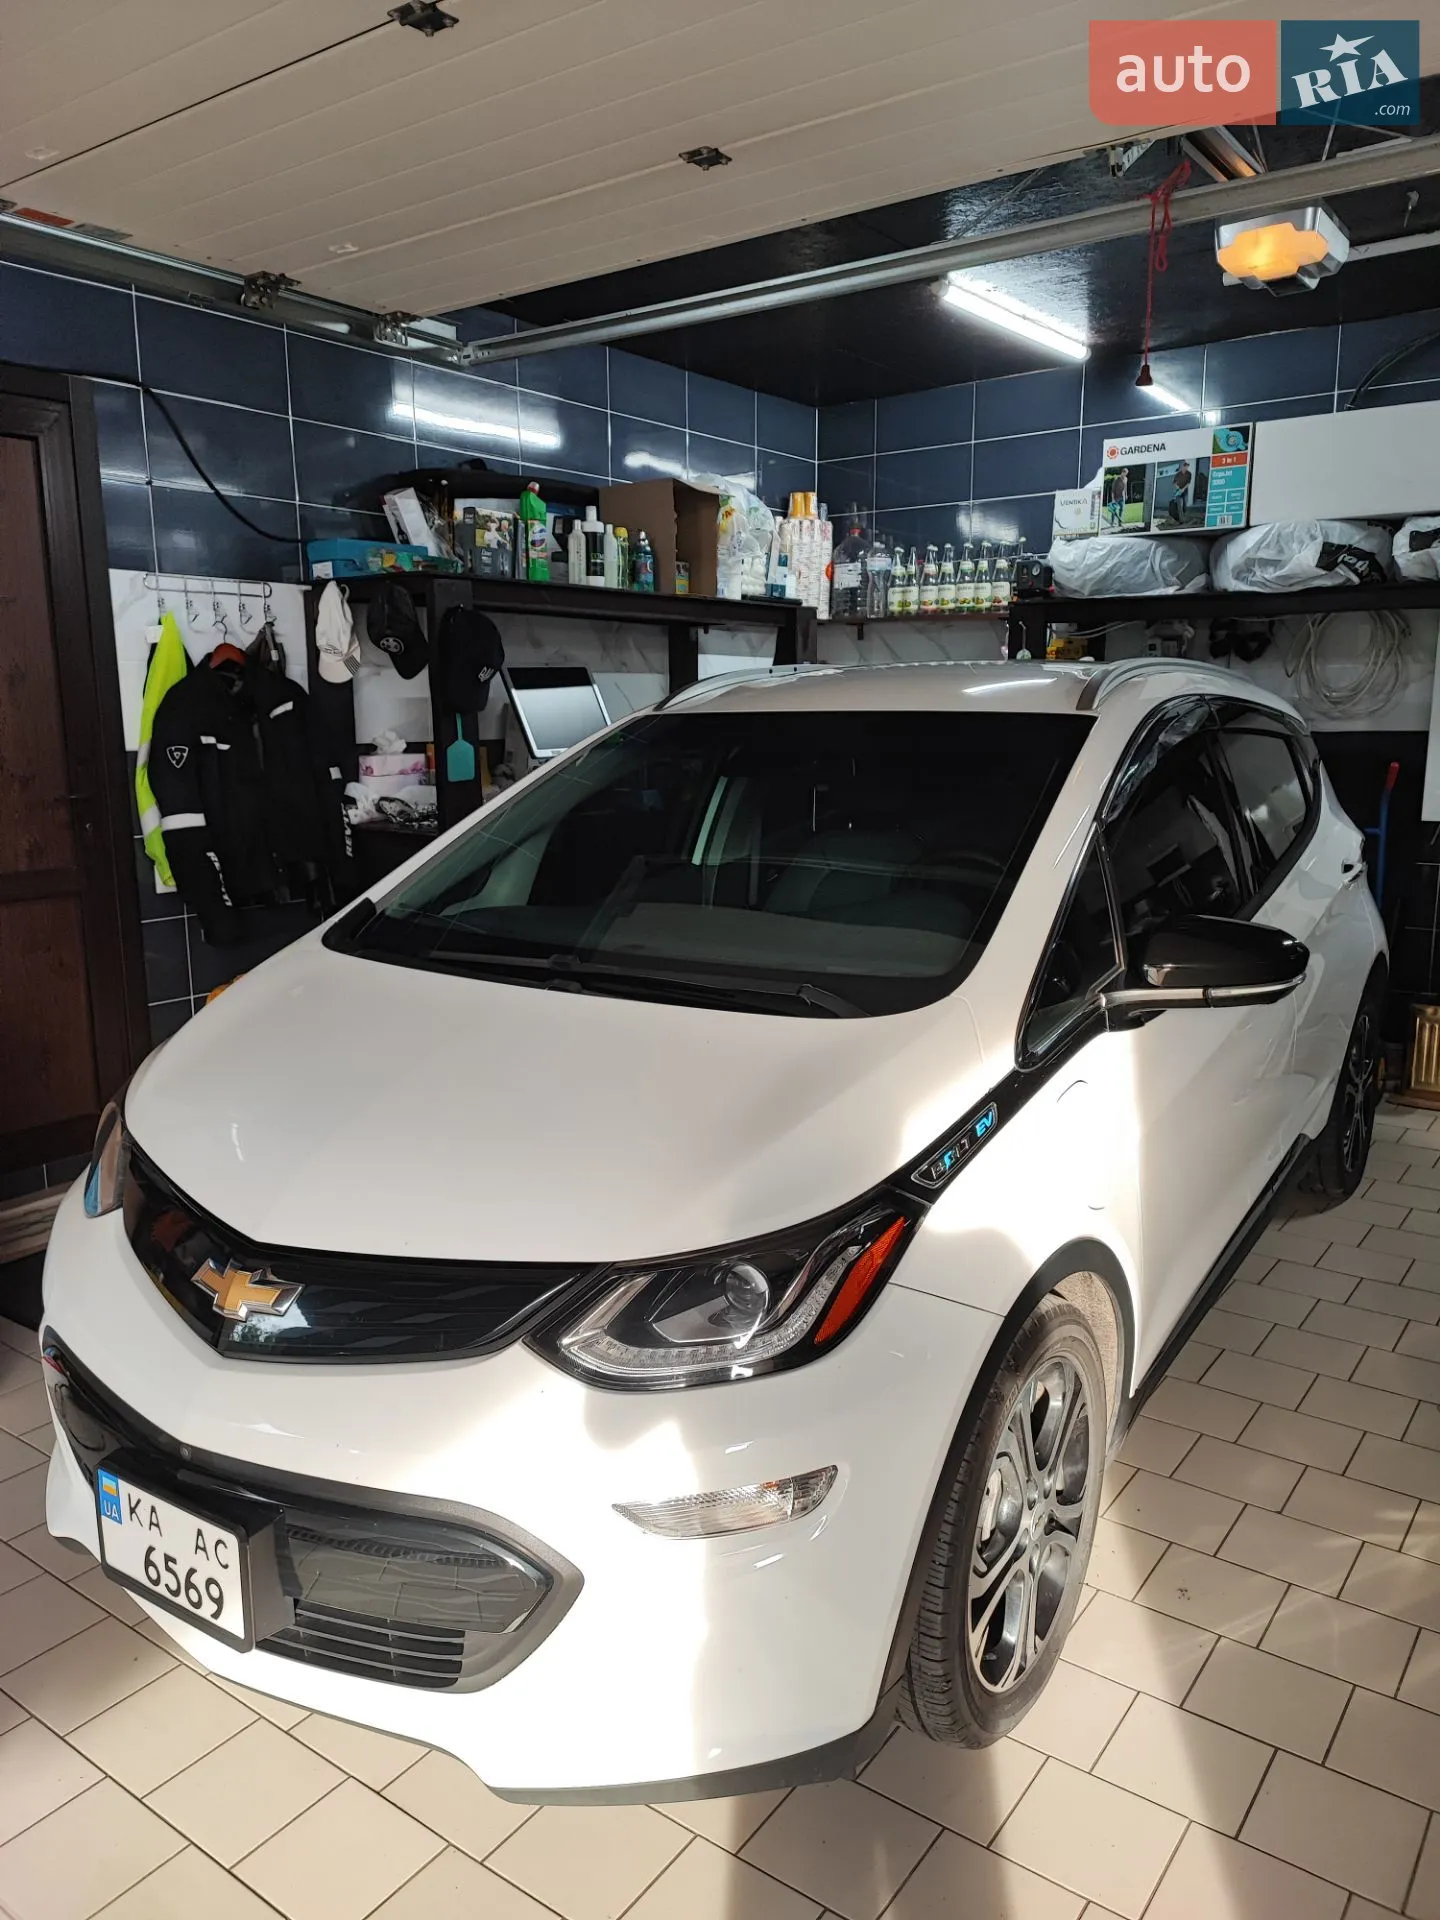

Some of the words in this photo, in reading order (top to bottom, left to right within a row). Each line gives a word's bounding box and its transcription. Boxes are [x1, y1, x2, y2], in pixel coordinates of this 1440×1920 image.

[1120, 442, 1167, 456] GARDENA
[975, 1111, 994, 1137] EV
[103, 1501, 120, 1520] UA
[128, 1493, 163, 1537] KA
[195, 1528, 230, 1570] AC
[144, 1545, 225, 1620] 6569
